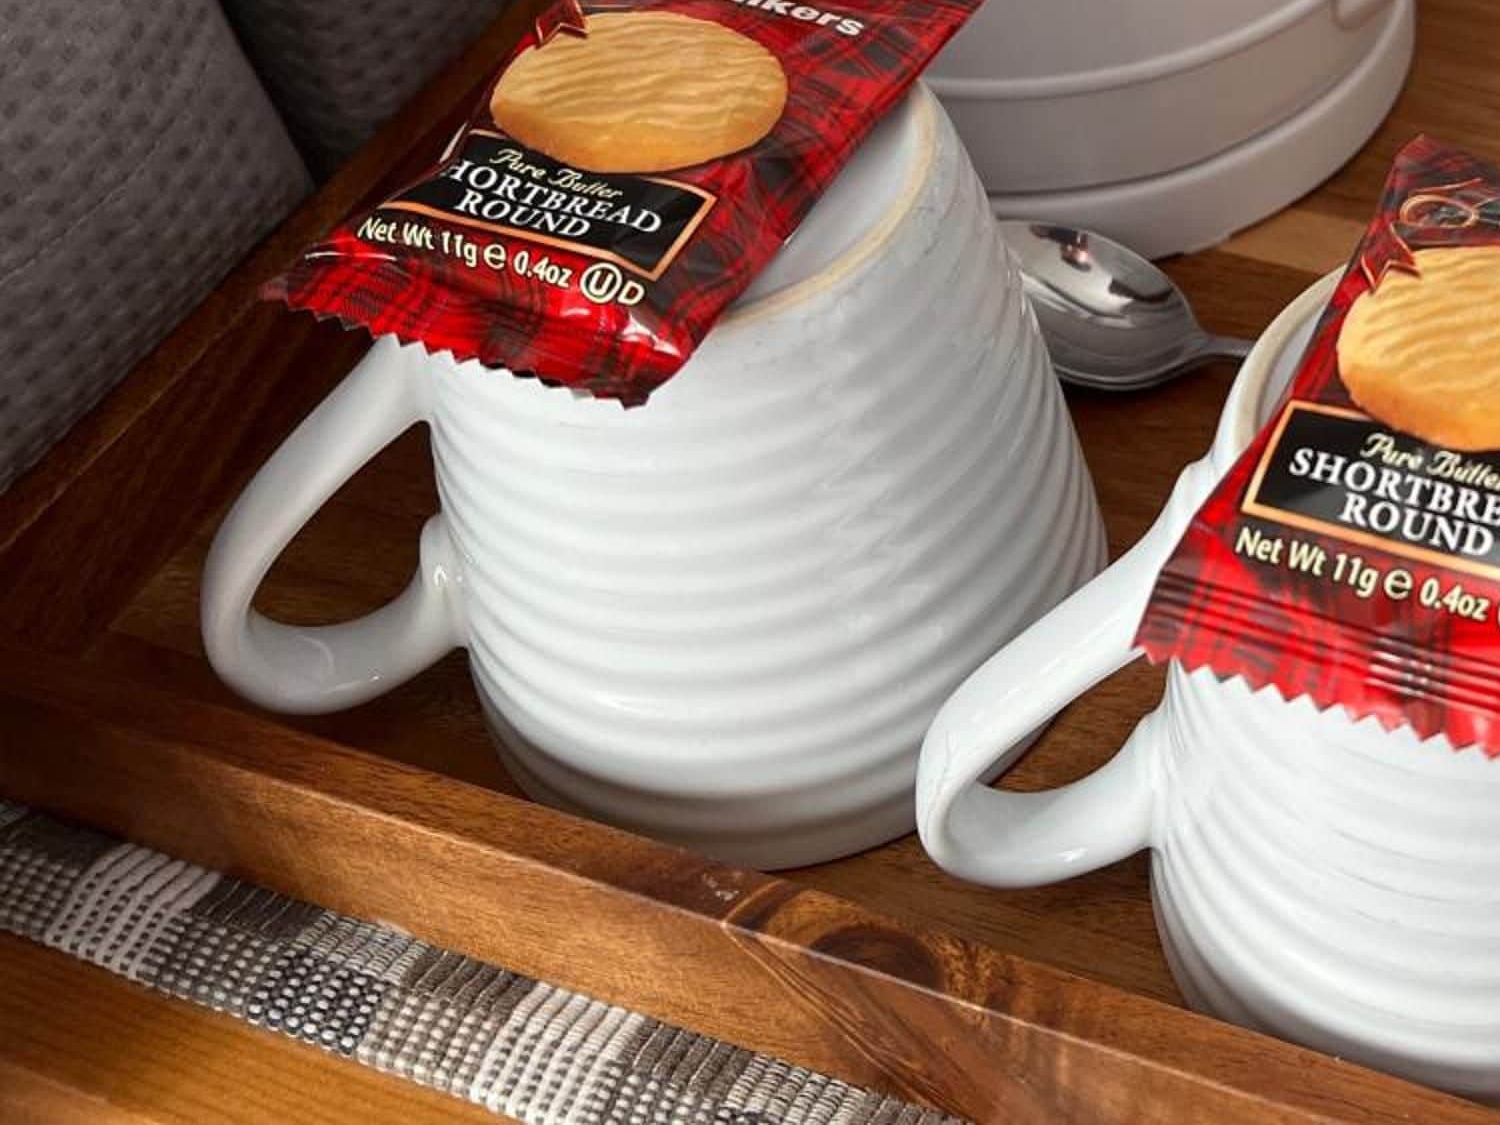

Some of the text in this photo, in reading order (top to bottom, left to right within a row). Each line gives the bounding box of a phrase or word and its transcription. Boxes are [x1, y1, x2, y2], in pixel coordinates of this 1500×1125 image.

[447, 160, 663, 233] HORTBREAD
[489, 148, 623, 199] Pure Butter
[454, 188, 592, 238] ROUND
[357, 216, 397, 244] Net
[402, 222, 435, 250] Wt
[441, 231, 478, 267] 11g
[513, 250, 573, 288] 0.4oz
[1360, 432, 1421, 469] Pure
[1339, 492, 1495, 557] ROUND
[1235, 526, 1280, 564] Net
[1288, 539, 1328, 576] Wt
[1333, 552, 1379, 599] 11g
[1419, 577, 1491, 622] 0.4oz
